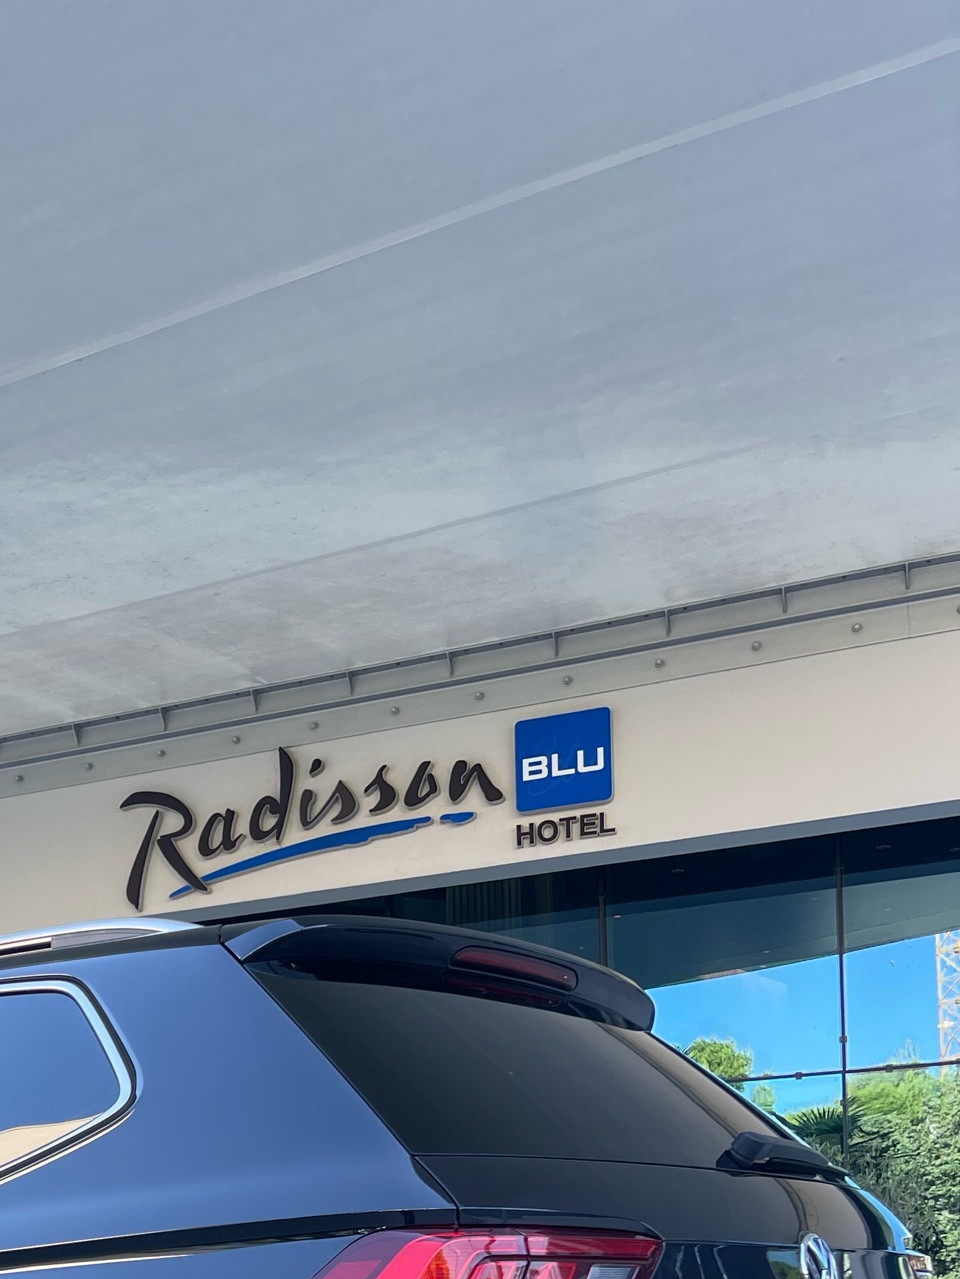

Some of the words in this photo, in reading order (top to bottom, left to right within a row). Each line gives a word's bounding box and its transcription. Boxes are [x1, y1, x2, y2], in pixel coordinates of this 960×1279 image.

[120, 746, 505, 910] Radisson
[522, 747, 605, 782] BLU
[515, 812, 617, 848] HOTEL
